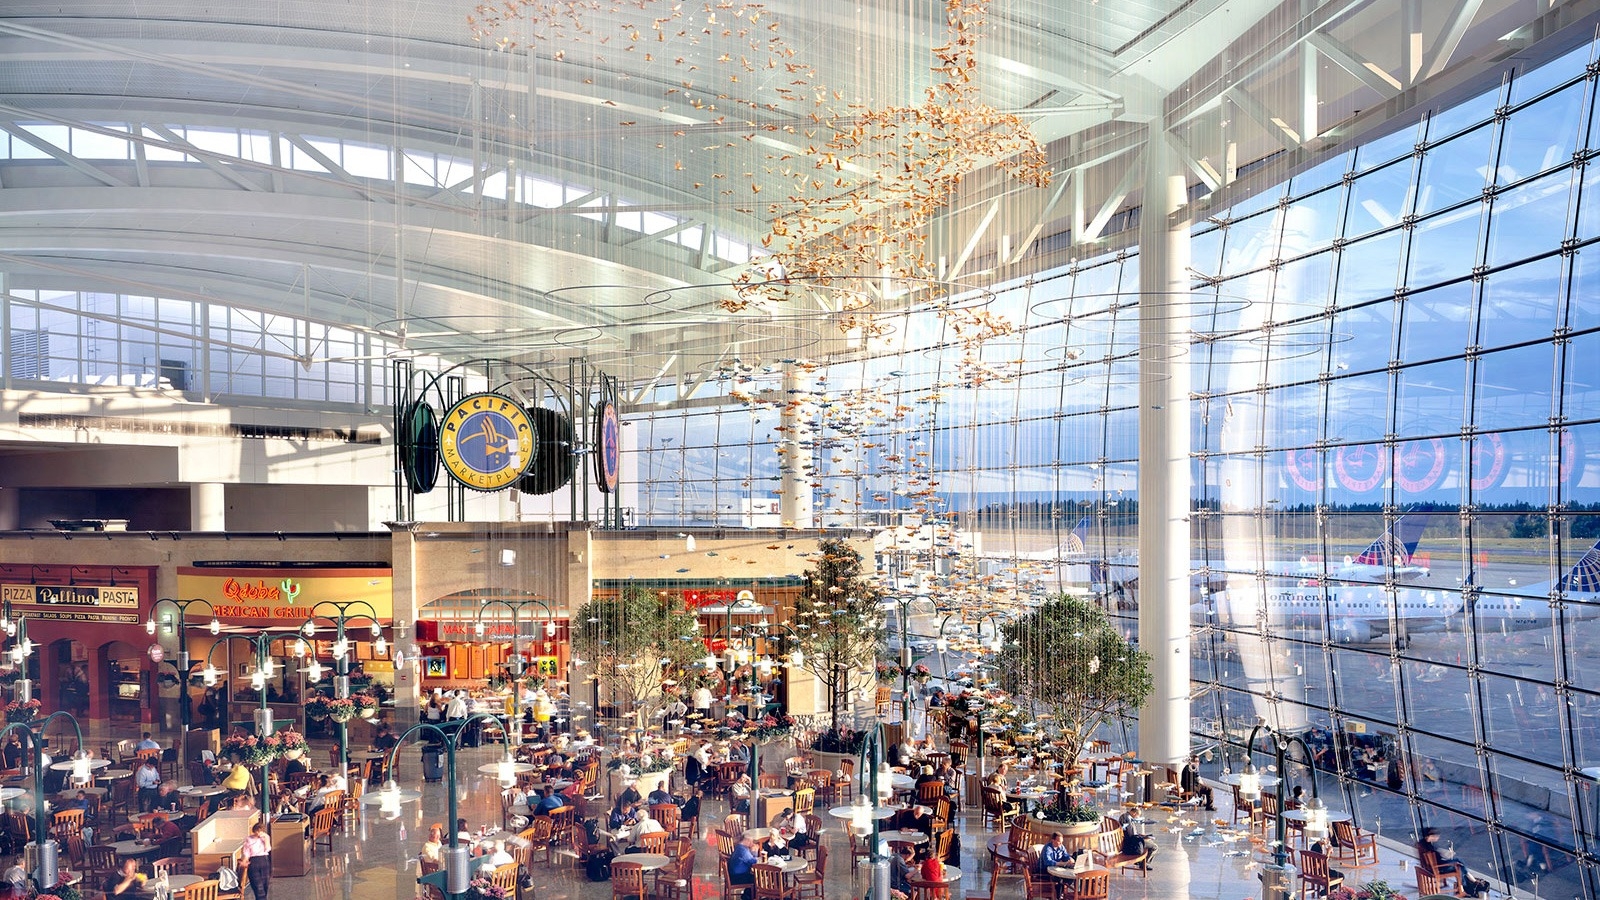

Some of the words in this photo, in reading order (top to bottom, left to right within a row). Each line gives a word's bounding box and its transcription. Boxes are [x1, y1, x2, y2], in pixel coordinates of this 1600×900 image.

[446, 399, 528, 432] PACIFIC
[3, 588, 33, 601] PIZZA
[40, 588, 95, 604] Pallino
[102, 591, 135, 604] PASTA
[223, 577, 280, 603] Qdoba
[213, 605, 269, 618] MEXICAN
[274, 606, 316, 619] GRILL
[443, 625, 468, 635] MAKI
